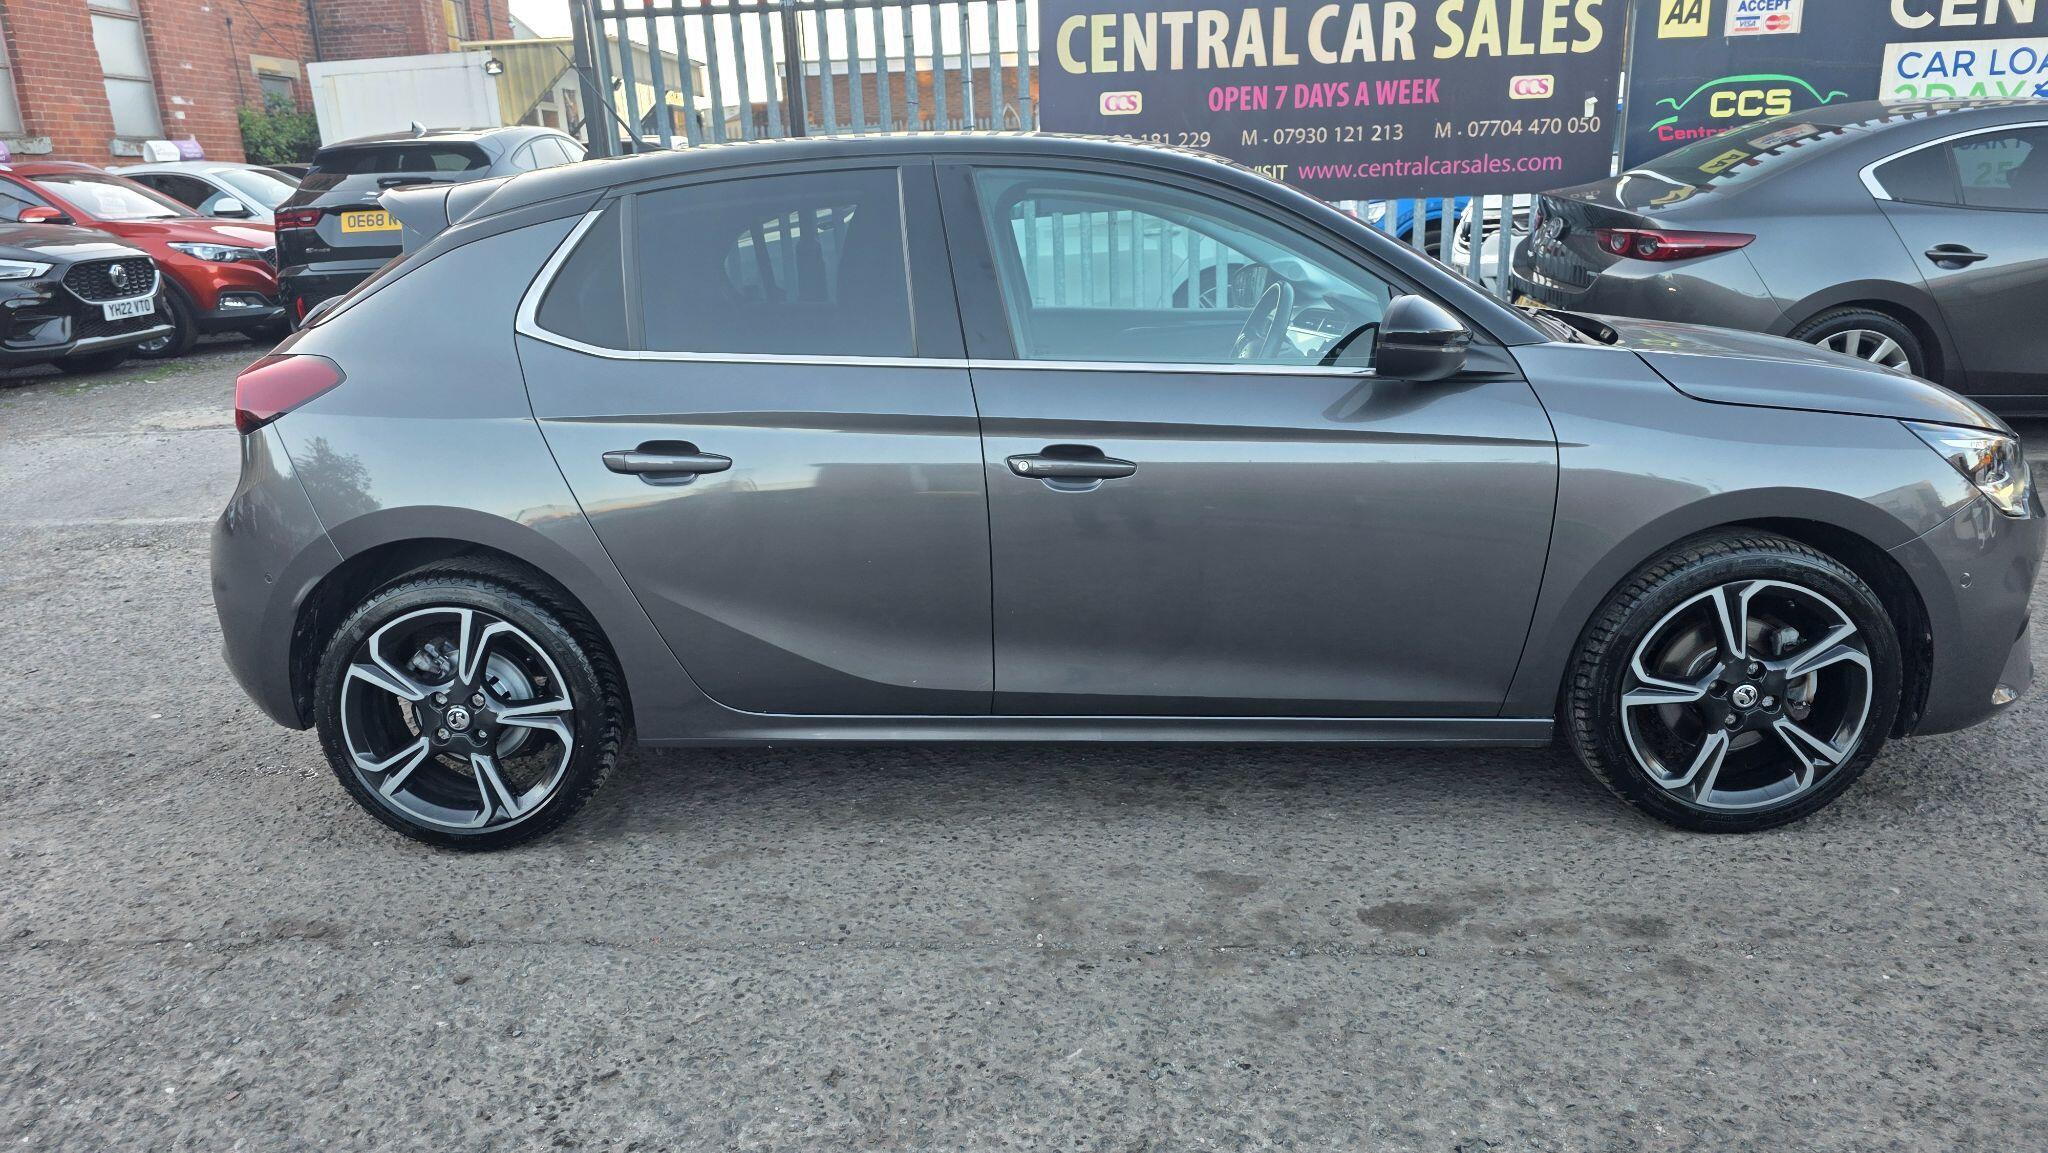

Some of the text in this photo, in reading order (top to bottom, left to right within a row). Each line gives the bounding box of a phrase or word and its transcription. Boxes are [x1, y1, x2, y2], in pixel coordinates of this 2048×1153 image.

[1664, 0, 1702, 25] AA
[1738, 0, 1791, 12] ACCEPT
[1056, 0, 1603, 74] CENTRAL CAR SALES
[1897, 51, 1976, 79] CAR
[1208, 78, 1441, 112] OPEN 7 DAYS A WEEK
[1709, 88, 1792, 118] CCS
[1179, 131, 1211, 148] 229
[1241, 129, 1258, 146] M
[1273, 127, 1328, 144] 07930
[1334, 125, 1363, 142] 121
[1371, 123, 1404, 141] 213
[1434, 122, 1451, 139] M
[1467, 119, 1523, 137] 07704
[1528, 118, 1561, 135] 470
[1567, 117, 1600, 133] 050
[1657, 124, 1734, 141] Centr
[1298, 153, 1563, 180] www.centralcarsales.com
[347, 213, 385, 228] OE68
[108, 302, 133, 317] YH22
